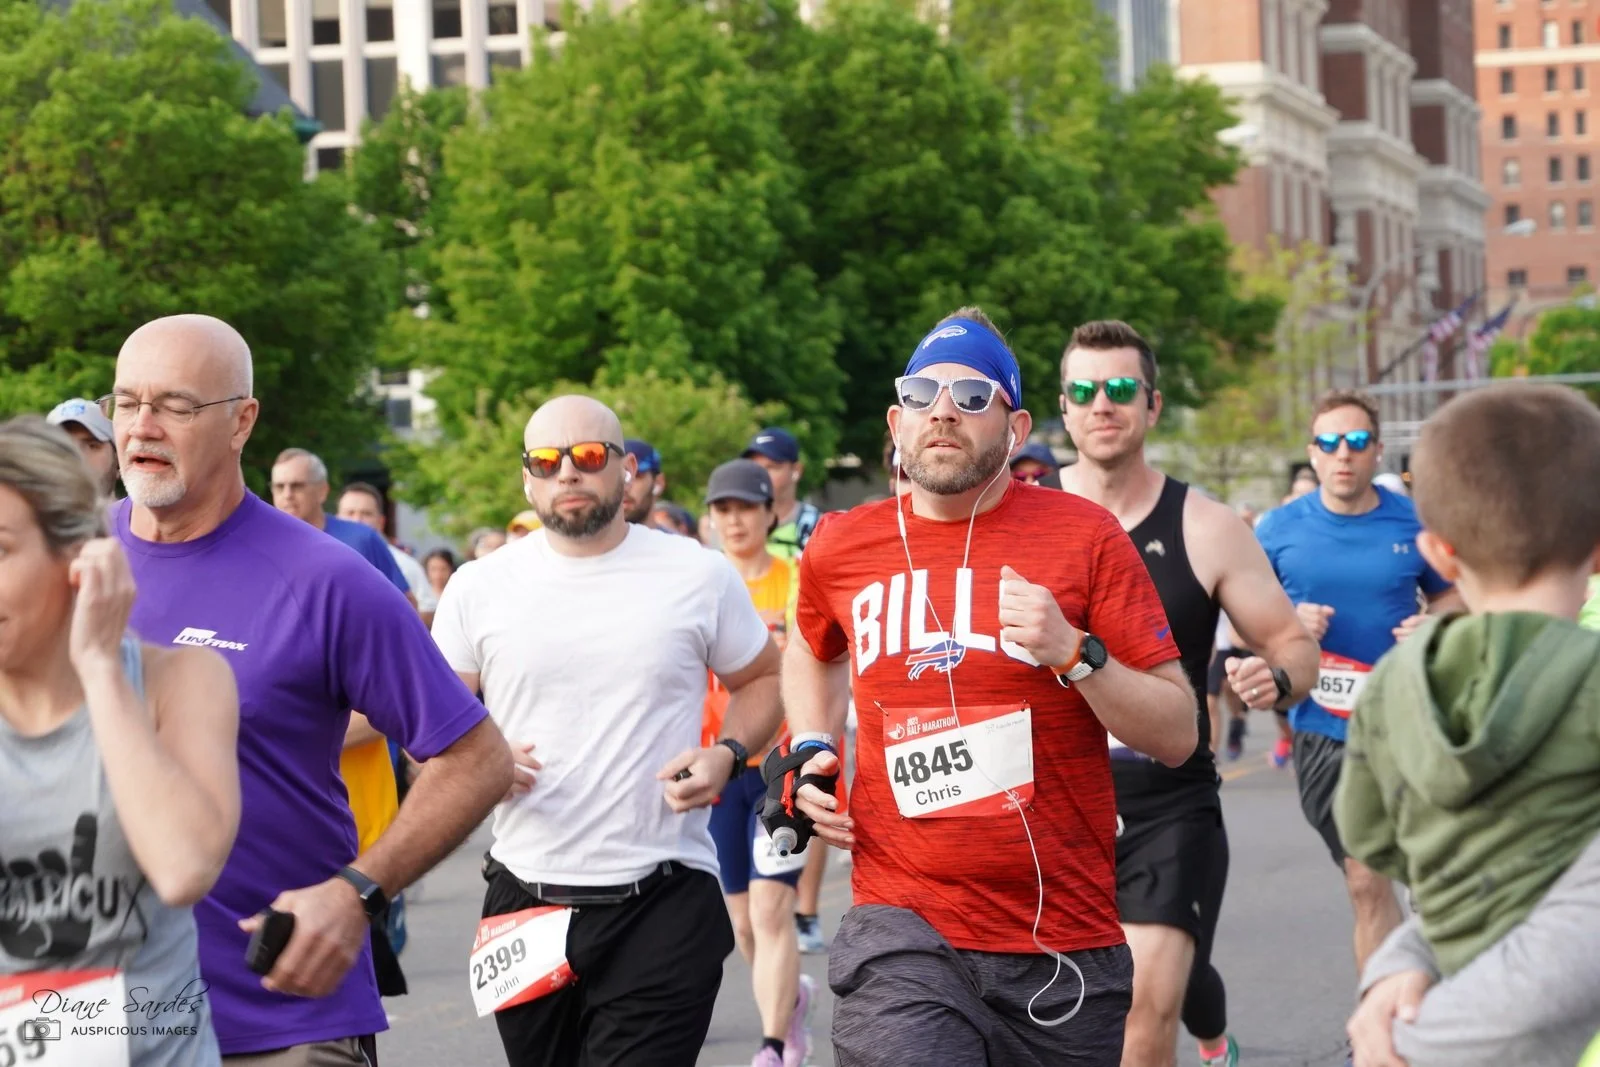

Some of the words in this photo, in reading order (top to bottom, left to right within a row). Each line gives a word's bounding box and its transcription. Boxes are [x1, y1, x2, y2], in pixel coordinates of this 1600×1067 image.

[1313, 676, 1356, 694] 657
[906, 724, 921, 736] HALF
[922, 715, 957, 733] MARATHON
[893, 739, 974, 787] 4845
[915, 784, 962, 806] Chris
[473, 938, 527, 991] 2399
[494, 975, 520, 999] John
